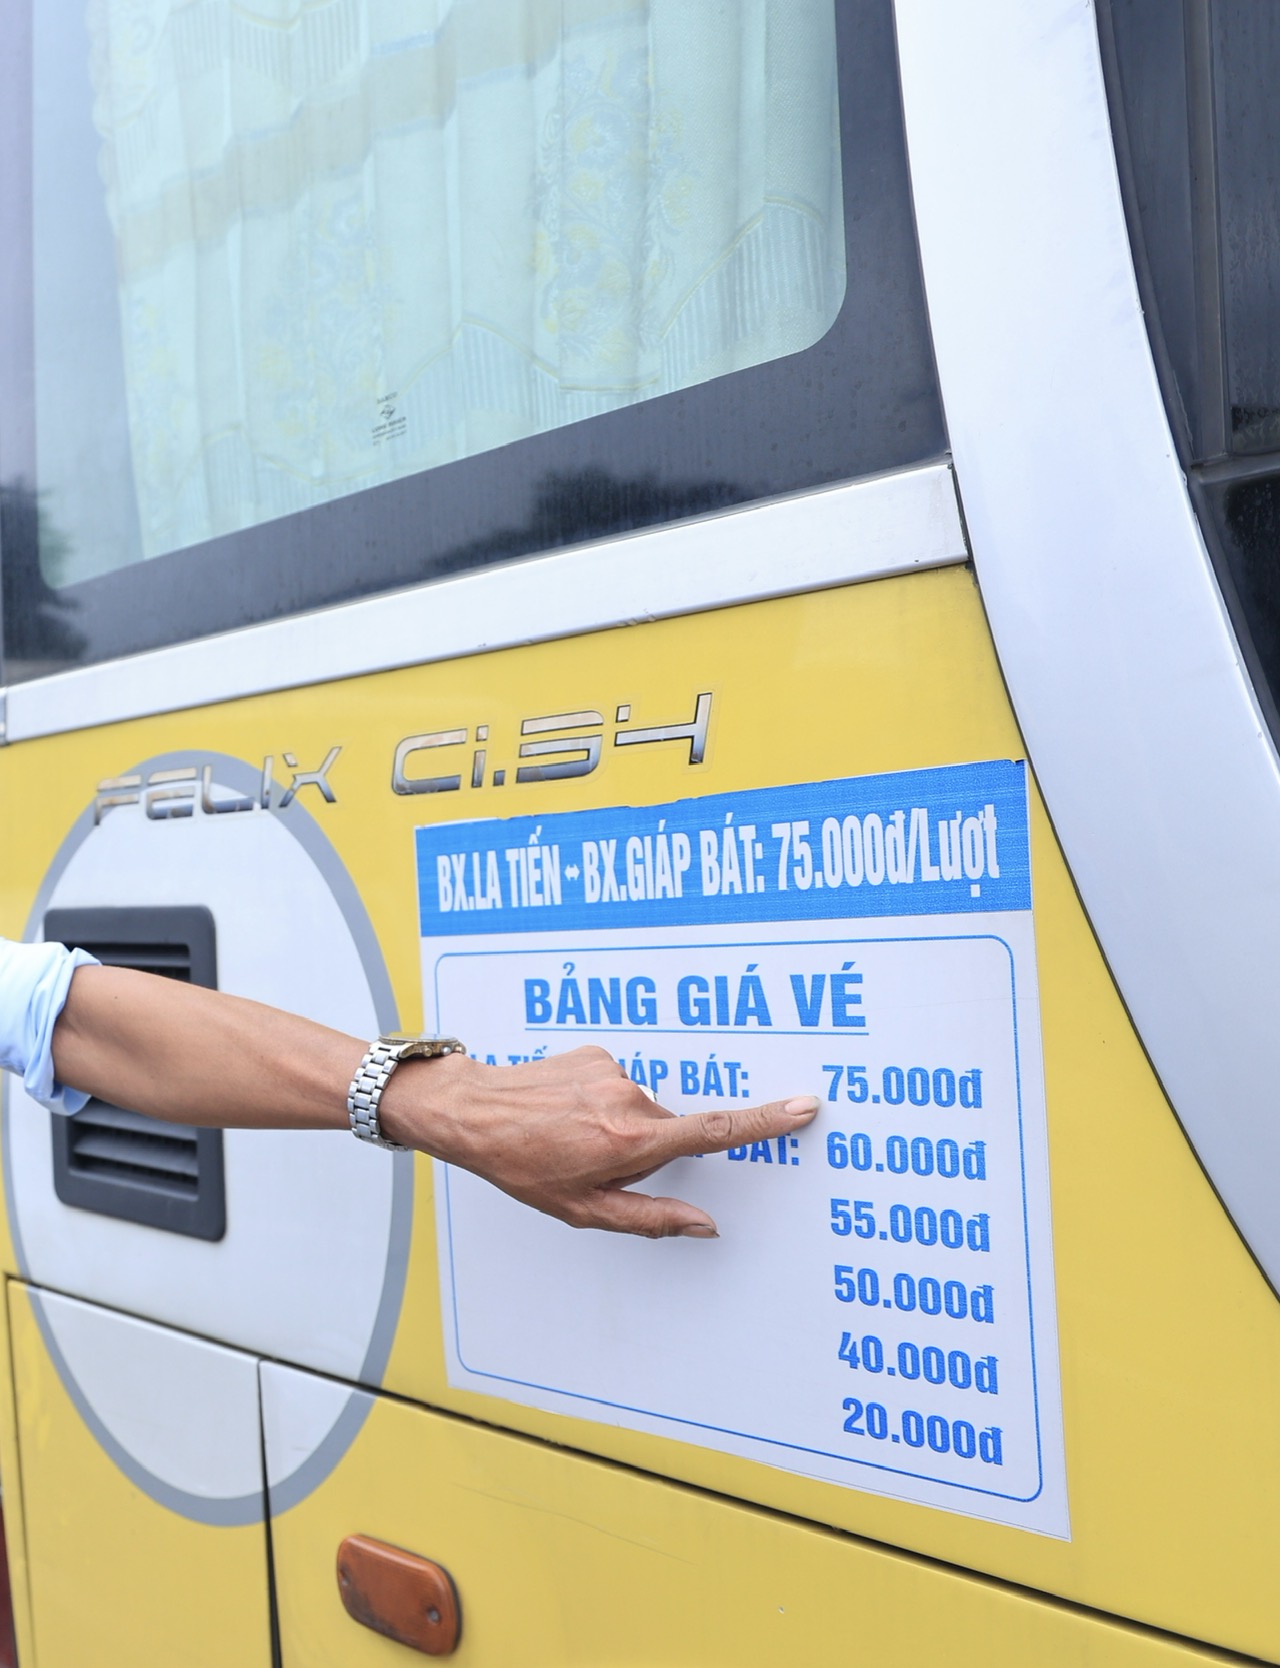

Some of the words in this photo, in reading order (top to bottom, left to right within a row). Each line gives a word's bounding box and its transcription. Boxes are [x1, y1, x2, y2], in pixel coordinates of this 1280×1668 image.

[94, 746, 342, 826] FELIX
[437, 850, 503, 912] BX.LA
[505, 825, 562, 908] TIẾN
[582, 819, 691, 904] BX.GIÁP
[699, 812, 765, 897] BÁT:
[771, 804, 1000, 898] 75.000đ/Lượt
[524, 961, 658, 1026] BẢNG
[676, 963, 772, 1027] GIÁ
[789, 961, 866, 1028] VÉ
[679, 1053, 750, 1098] BÁT:
[822, 1065, 983, 1108] 75.000đ
[826, 1131, 987, 1181] 60.000đ
[830, 1198, 991, 1252] 55.000đ
[834, 1264, 994, 1324] 50.000đ
[837, 1331, 999, 1395] 40.000đ
[842, 1397, 1003, 1465] 20.000đ
